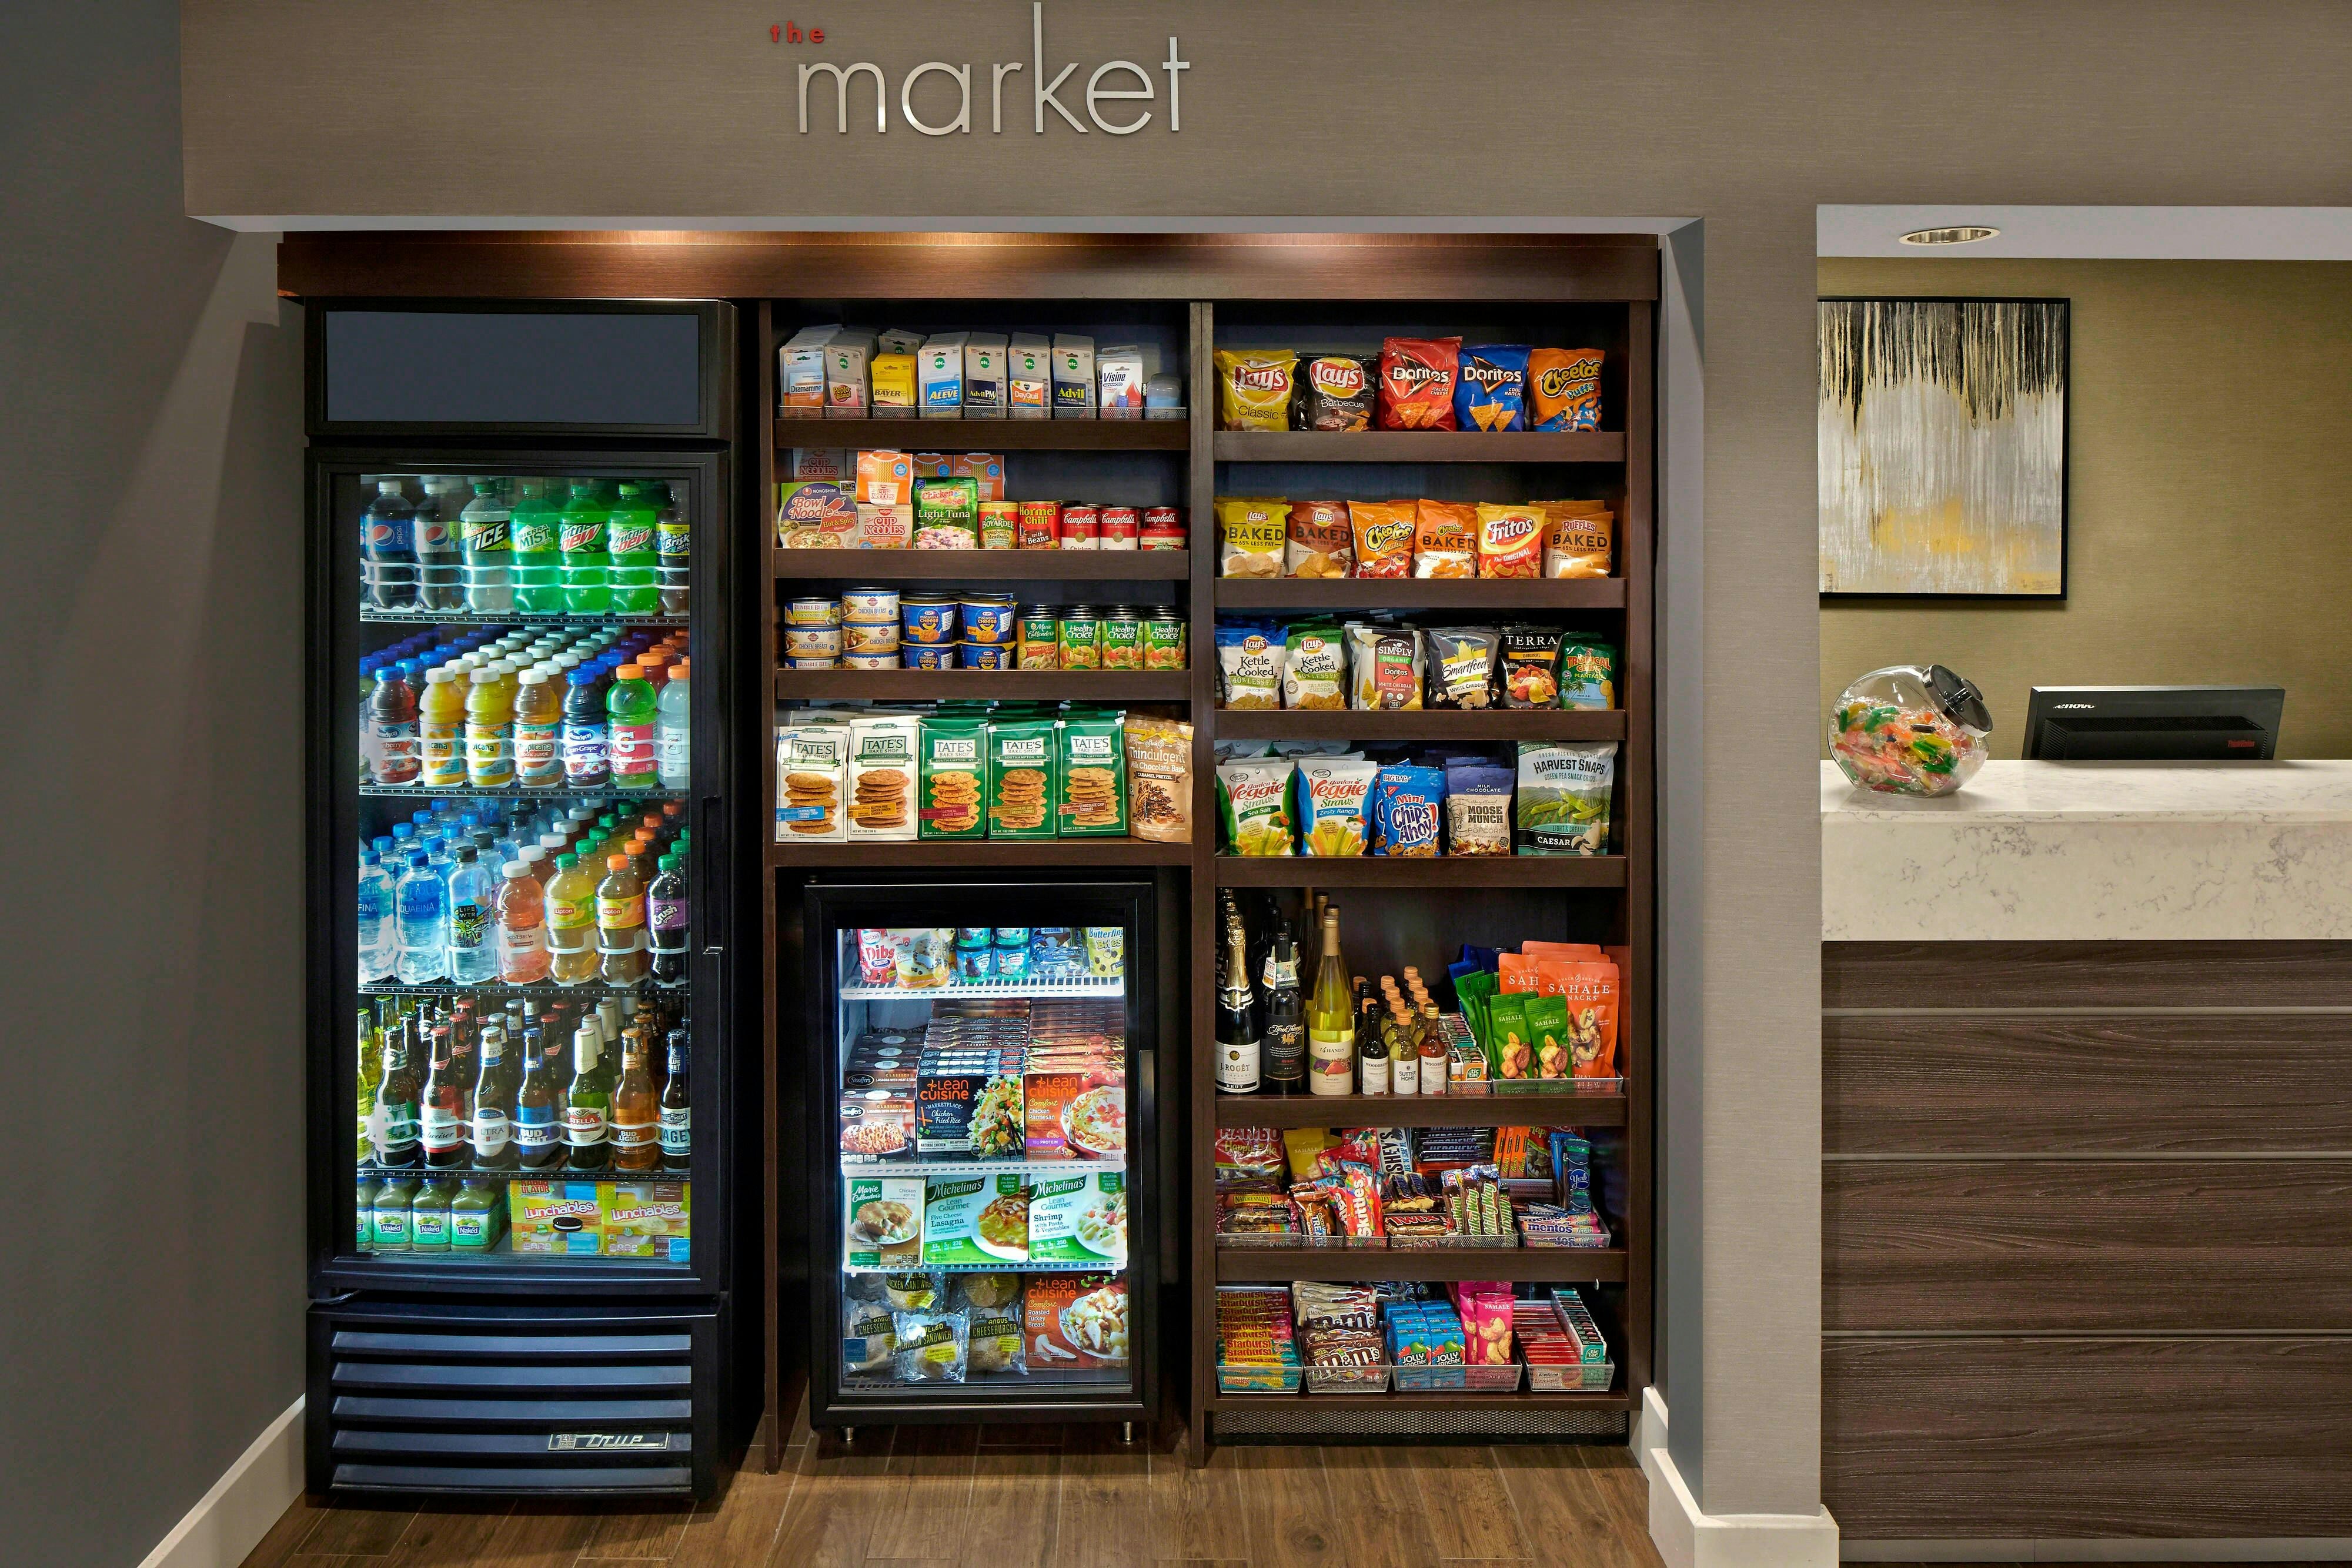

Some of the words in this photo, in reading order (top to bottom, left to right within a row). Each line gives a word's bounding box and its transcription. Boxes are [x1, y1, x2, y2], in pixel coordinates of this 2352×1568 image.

[770, 21, 824, 43] the
[799, 2, 1190, 136] market
[1103, 372, 1126, 383] Visine
[1239, 367, 1284, 391] Lay's
[1316, 362, 1361, 388] Lay's
[1393, 366, 1449, 383] Doritos
[1464, 366, 1522, 383] Doritos
[1541, 358, 1602, 397] Cheetos
[791, 385, 822, 393] Dramamine
[929, 389, 958, 400] ALEVE
[1058, 387, 1084, 399] Advil
[1015, 391, 1038, 400] DayQuil
[1321, 399, 1364, 409] Barbecue
[1238, 405, 1279, 420] Classic
[800, 466, 838, 476] NOODLES
[918, 510, 944, 520] Light
[947, 510, 970, 519] Tuna
[1020, 506, 1055, 516] Hormel
[874, 517, 897, 526] CUP
[982, 520, 1014, 530] BOYARDEE
[1562, 520, 1596, 533] RUFFLES
[395, 526, 404, 545] pepsi
[865, 525, 905, 536] NOODLES
[1229, 527, 1284, 541] BAKED
[1295, 527, 1349, 541] BAKED
[1437, 524, 1463, 536] Cheetos
[1486, 518, 1534, 544] Fritos
[475, 523, 505, 550] ICE
[519, 529, 549, 548] MIST
[1027, 535, 1049, 544] Beans
[1366, 521, 1414, 551] Cheetos
[1552, 533, 1608, 547] BAKED
[1423, 536, 1476, 549] BAKED
[1070, 624, 1094, 634] Healthy
[1111, 624, 1137, 634] Healthy
[1155, 624, 1180, 634] Healthy
[1066, 631, 1093, 639] Choice
[1108, 631, 1135, 639] Choice
[1151, 631, 1178, 640] Choice
[1506, 635, 1557, 646] TERRA
[1379, 643, 1412, 657] SIMPLY
[1240, 656, 1269, 667] Kettle
[1301, 654, 1330, 666] Kettle
[1566, 656, 1611, 670] TROPICAL
[1237, 667, 1274, 677] Cooked
[1300, 663, 1335, 674] Cooked
[1385, 668, 1408, 676] Doritos
[1442, 658, 1488, 679] Smartfood
[866, 739, 903, 749] TATE'S
[936, 742, 973, 752] TATE'S
[1004, 741, 1041, 749] TATE'S
[1073, 738, 1109, 748] TATE'S
[795, 743, 832, 755] TATE'S
[1129, 746, 1185, 764] Thindulgent
[1534, 759, 1576, 774] HARVEST
[1579, 759, 1603, 774] SNAPS
[1227, 781, 1285, 805] Veggie
[1309, 778, 1368, 799] Veggie
[1242, 797, 1274, 811] Straws
[1321, 798, 1354, 807] Straws
[1396, 794, 1425, 805] Mini
[1468, 806, 1502, 814] MOOSE
[1391, 804, 1430, 828] Chips
[1468, 815, 1503, 823] MUNCH
[1537, 836, 1570, 845] CAESAR
[654, 905, 677, 925] Crush
[866, 944, 896, 961] Dibs
[1549, 984, 1610, 994] SAHALE
[1535, 1018, 1559, 1027] SAHALE
[1029, 1098, 1058, 1108] Comfort
[1570, 1175, 1589, 1188] York
[928, 1180, 983, 1201] Michelina's
[1030, 1178, 1084, 1199] Michelina's
[524, 1201, 593, 1219] Lunchables
[612, 1205, 681, 1221] Lunchables
[1354, 1179, 1372, 1236] Skittles
[931, 1218, 964, 1227] Lasagna
[1034, 1213, 1063, 1222] Shrimp
[1529, 1224, 1573, 1233] mentos
[1028, 1299, 1057, 1308] Comfort
[973, 1324, 1017, 1336] CHEESEBURGER
[1227, 1339, 1271, 1348] Starburst
[1227, 1348, 1272, 1356] Starburst
[1436, 1352, 1458, 1363] JOLLY
[1402, 1353, 1424, 1363] JOLLY
